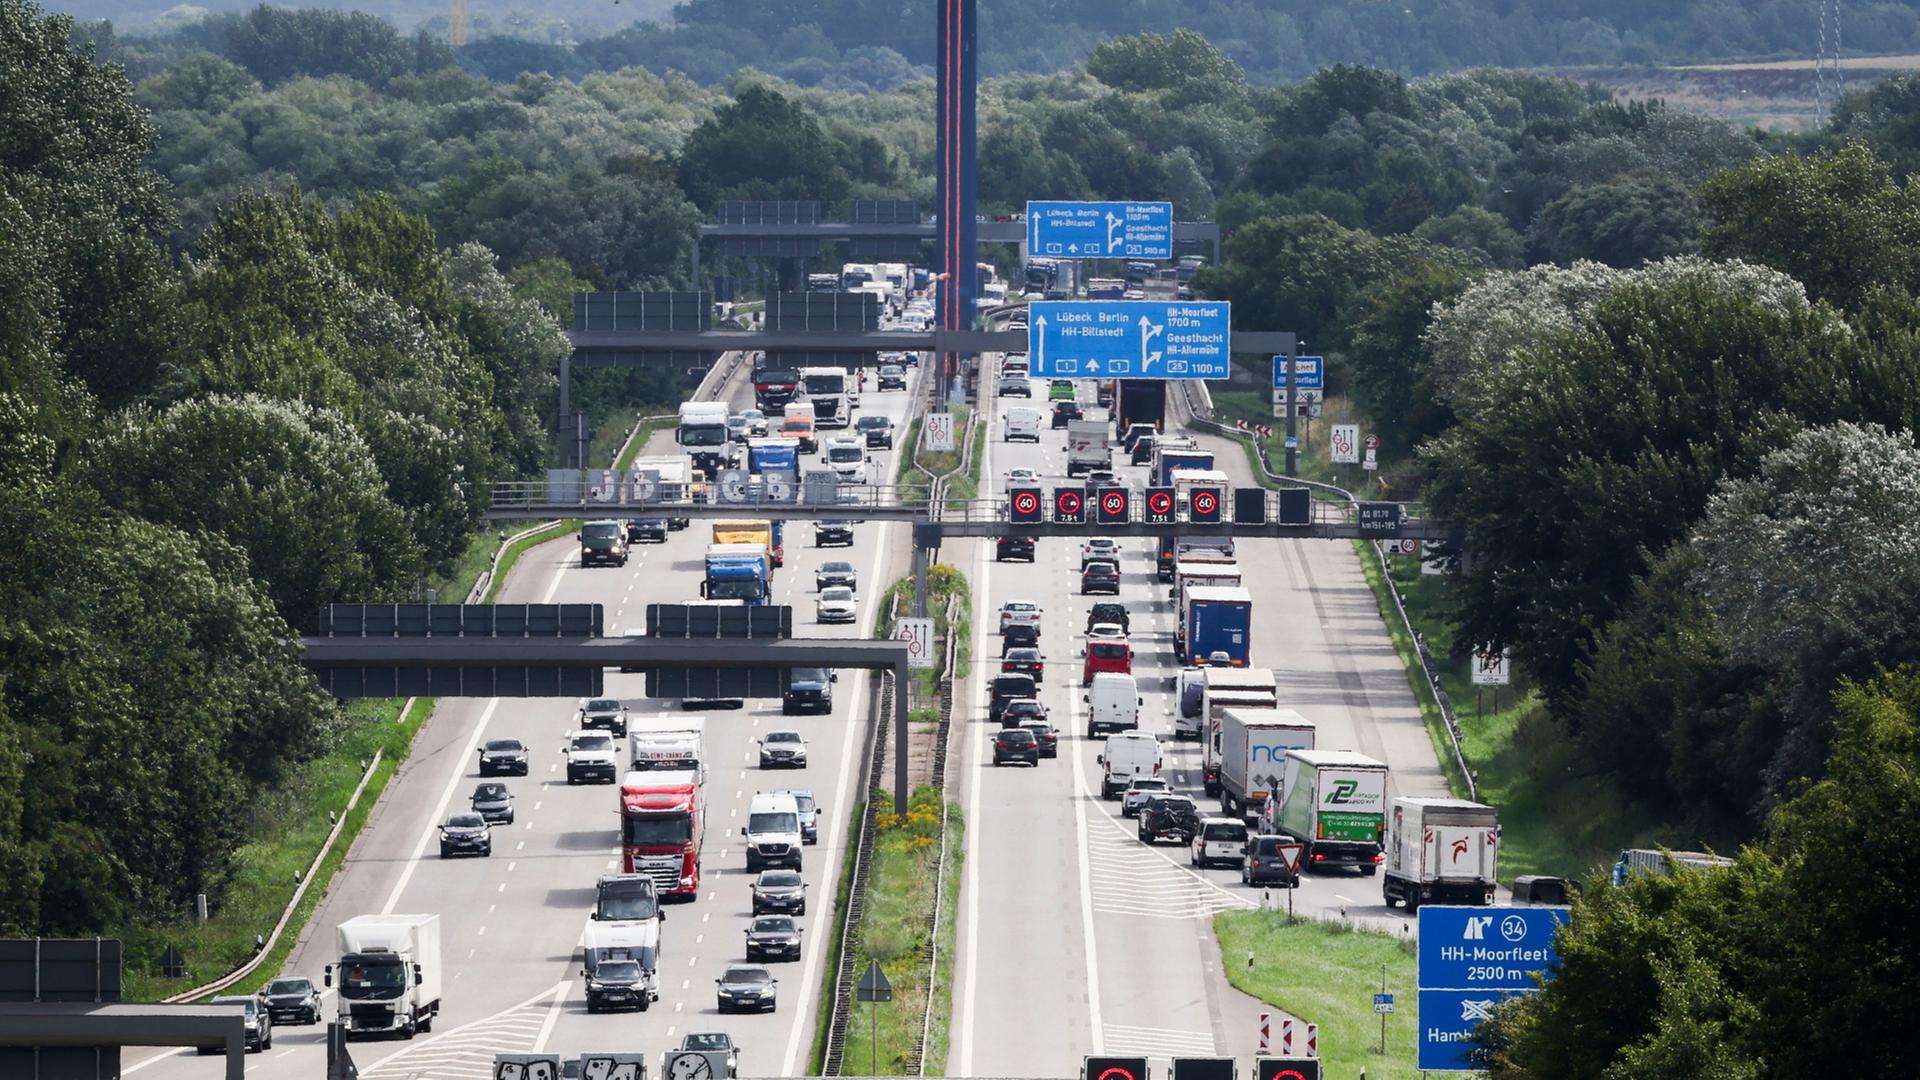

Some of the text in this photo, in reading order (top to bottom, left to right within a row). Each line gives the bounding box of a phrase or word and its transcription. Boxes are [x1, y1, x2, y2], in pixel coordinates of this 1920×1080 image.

[1047, 209, 1073, 217] Lübeck
[1056, 311, 1129, 322] Lübeck Berlin
[1167, 318, 1200, 328] 1700 m
[1061, 327, 1124, 337] HH-Billstedt
[1167, 333, 1223, 344] Geesthacht
[1192, 363, 1224, 374] 1100 m
[1019, 498, 1033, 508] 60
[1106, 498, 1120, 508] 60
[1198, 498, 1212, 508] 60
[1504, 921, 1523, 935] 34
[1441, 946, 1548, 961] HH-Moorfleet
[1467, 966, 1522, 980] 2500 m
